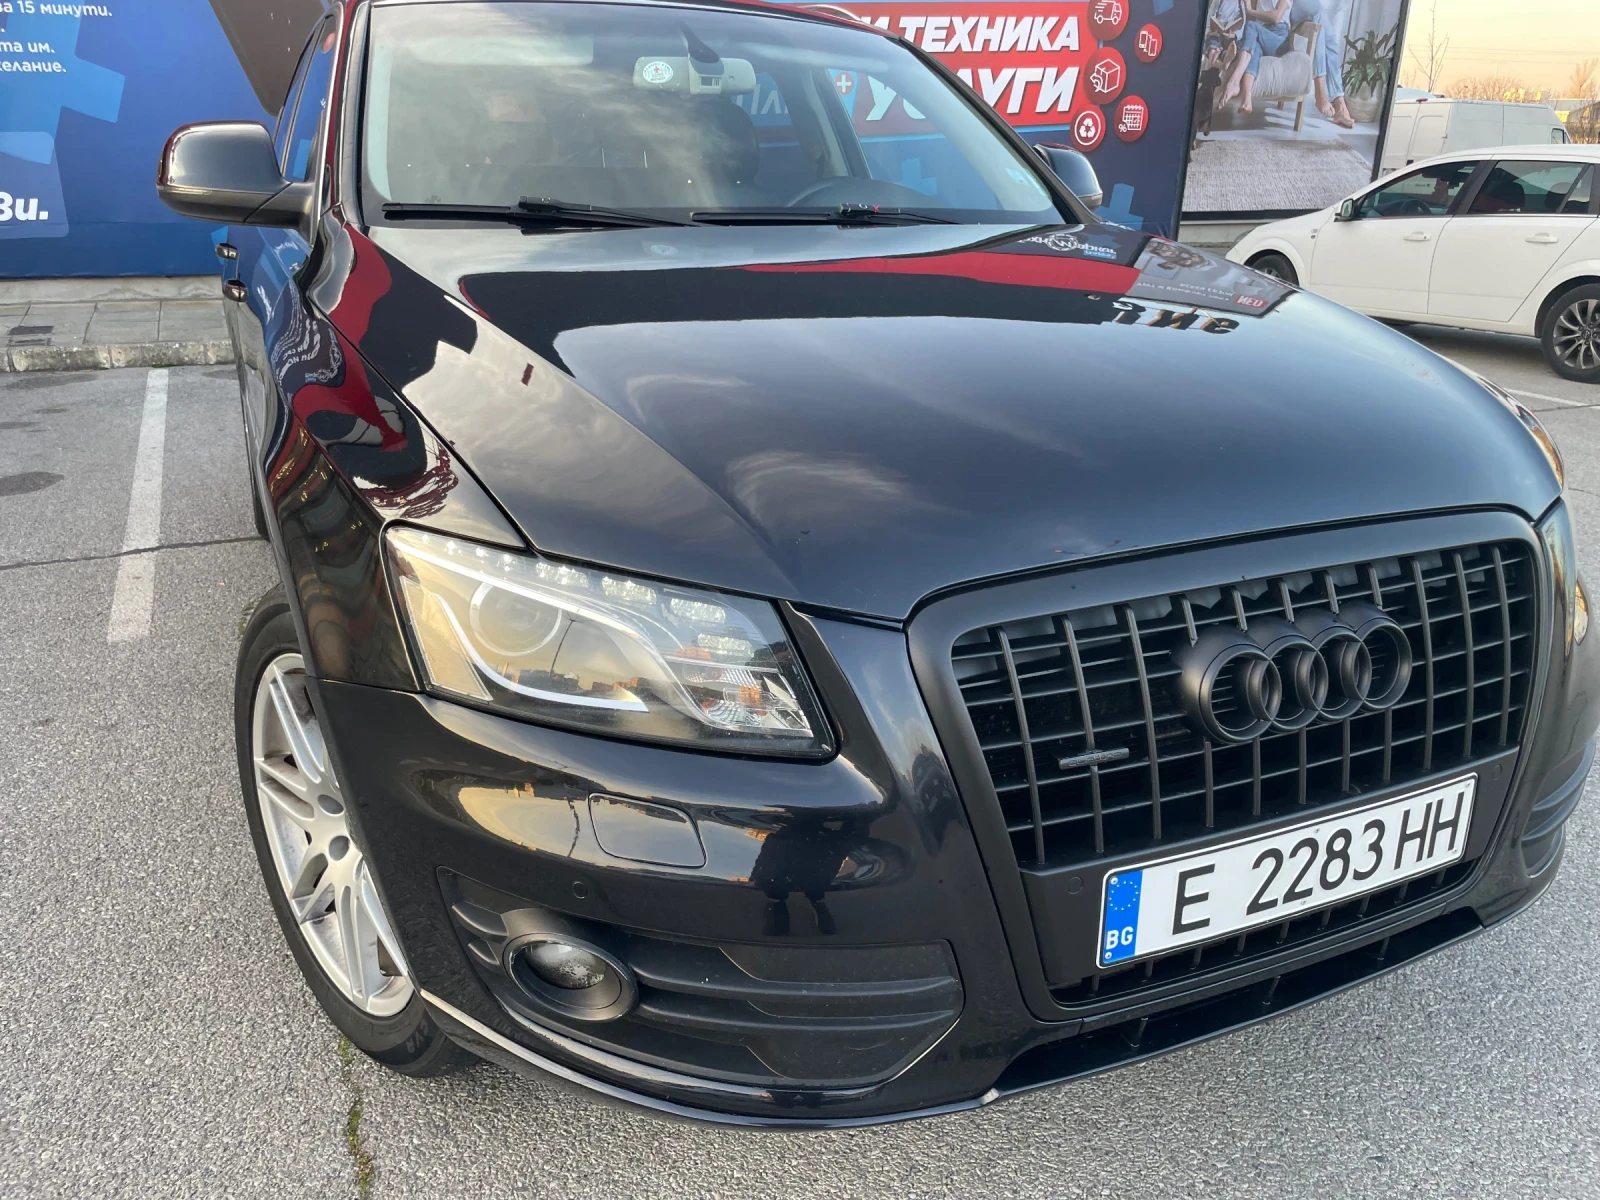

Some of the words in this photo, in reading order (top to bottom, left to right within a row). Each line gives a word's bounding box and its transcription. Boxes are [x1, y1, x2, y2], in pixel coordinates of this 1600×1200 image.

[16, 0, 35, 13] 15
[40, 3, 113, 18] минути.
[27, 41, 55, 53] им.
[898, 16, 1080, 53] ТЕХНИКА
[1171, 863, 1216, 936] E
[1245, 818, 1386, 916] 2283
[1393, 791, 1466, 871] HH
[1105, 926, 1134, 951] BG
